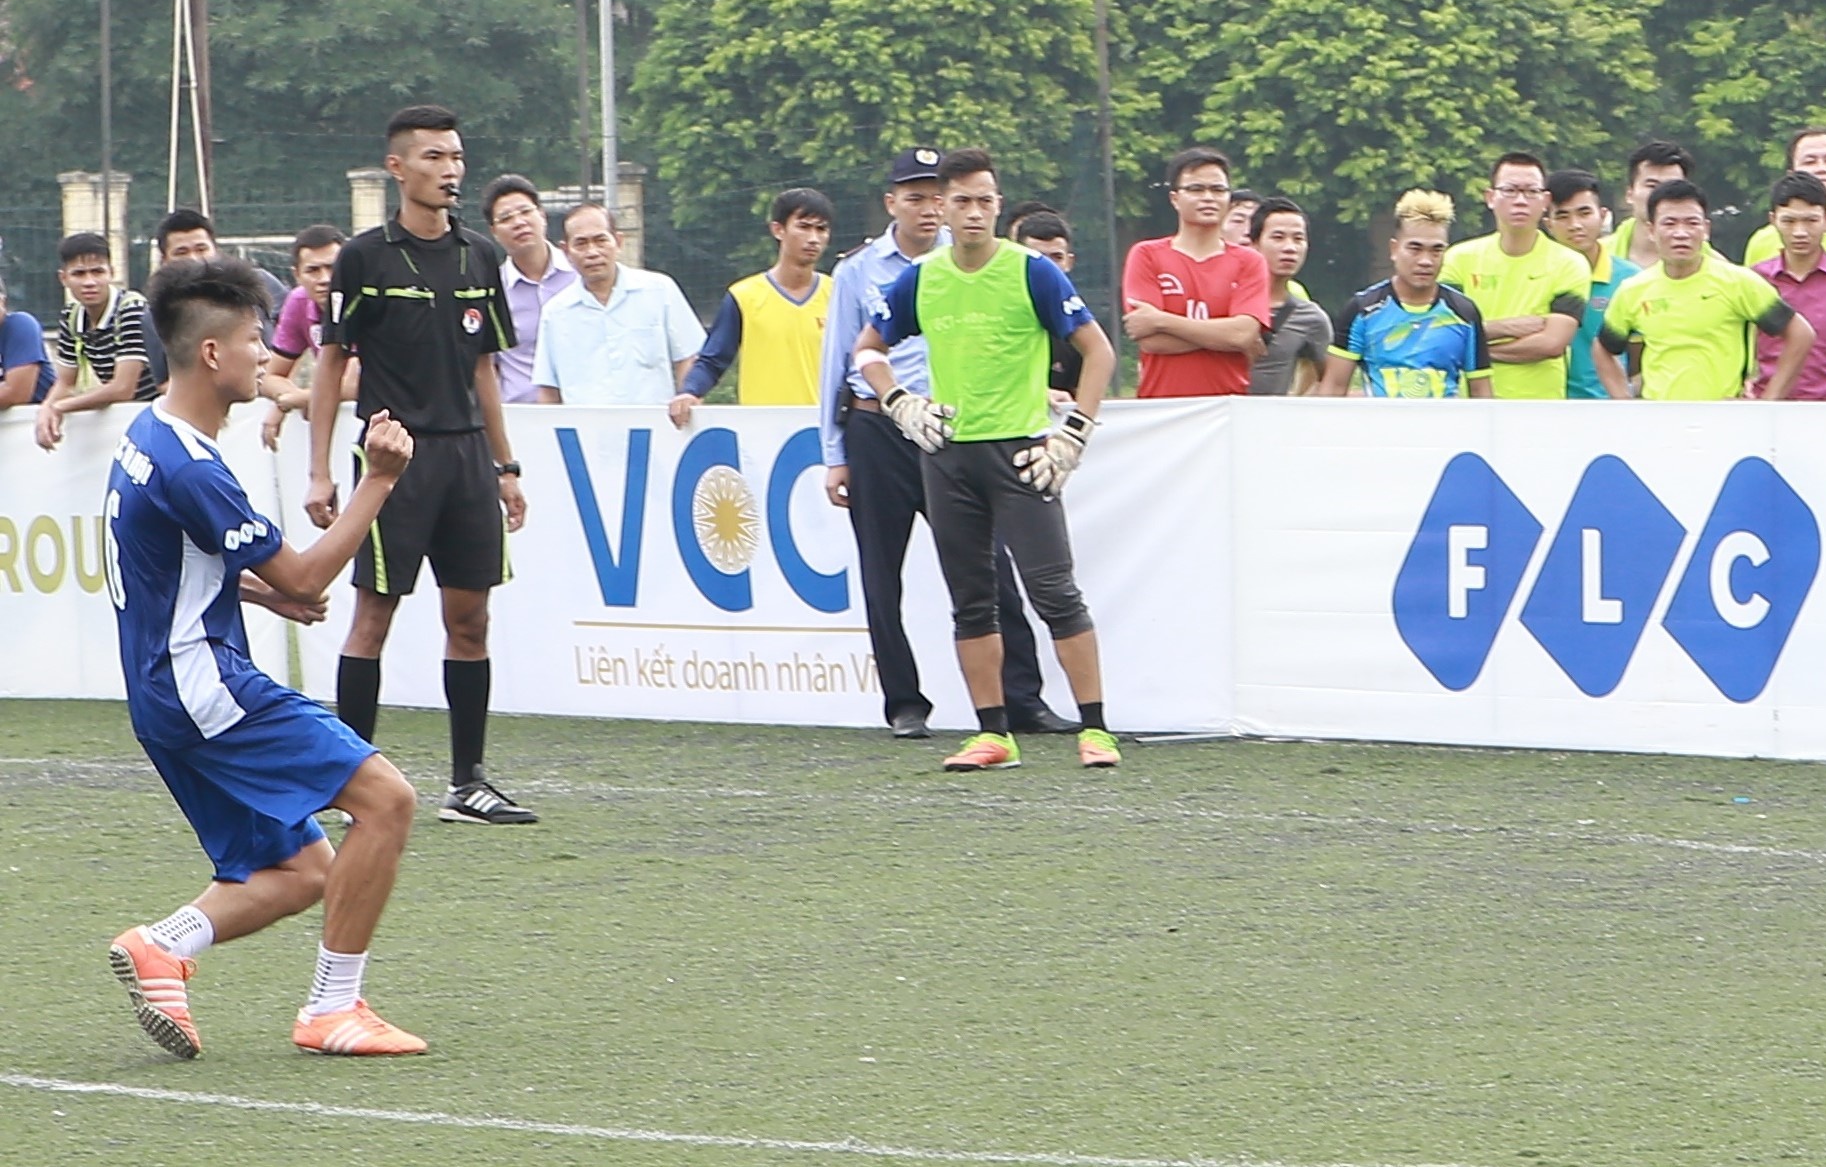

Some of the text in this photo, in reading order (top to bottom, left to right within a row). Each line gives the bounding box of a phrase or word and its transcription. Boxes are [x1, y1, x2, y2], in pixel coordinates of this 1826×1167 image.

[1448, 525, 1772, 630] FLC
[574, 644, 630, 687] Liên
[633, 642, 678, 689] kết
[683, 649, 770, 693] doanh
[775, 651, 848, 694] nhân
